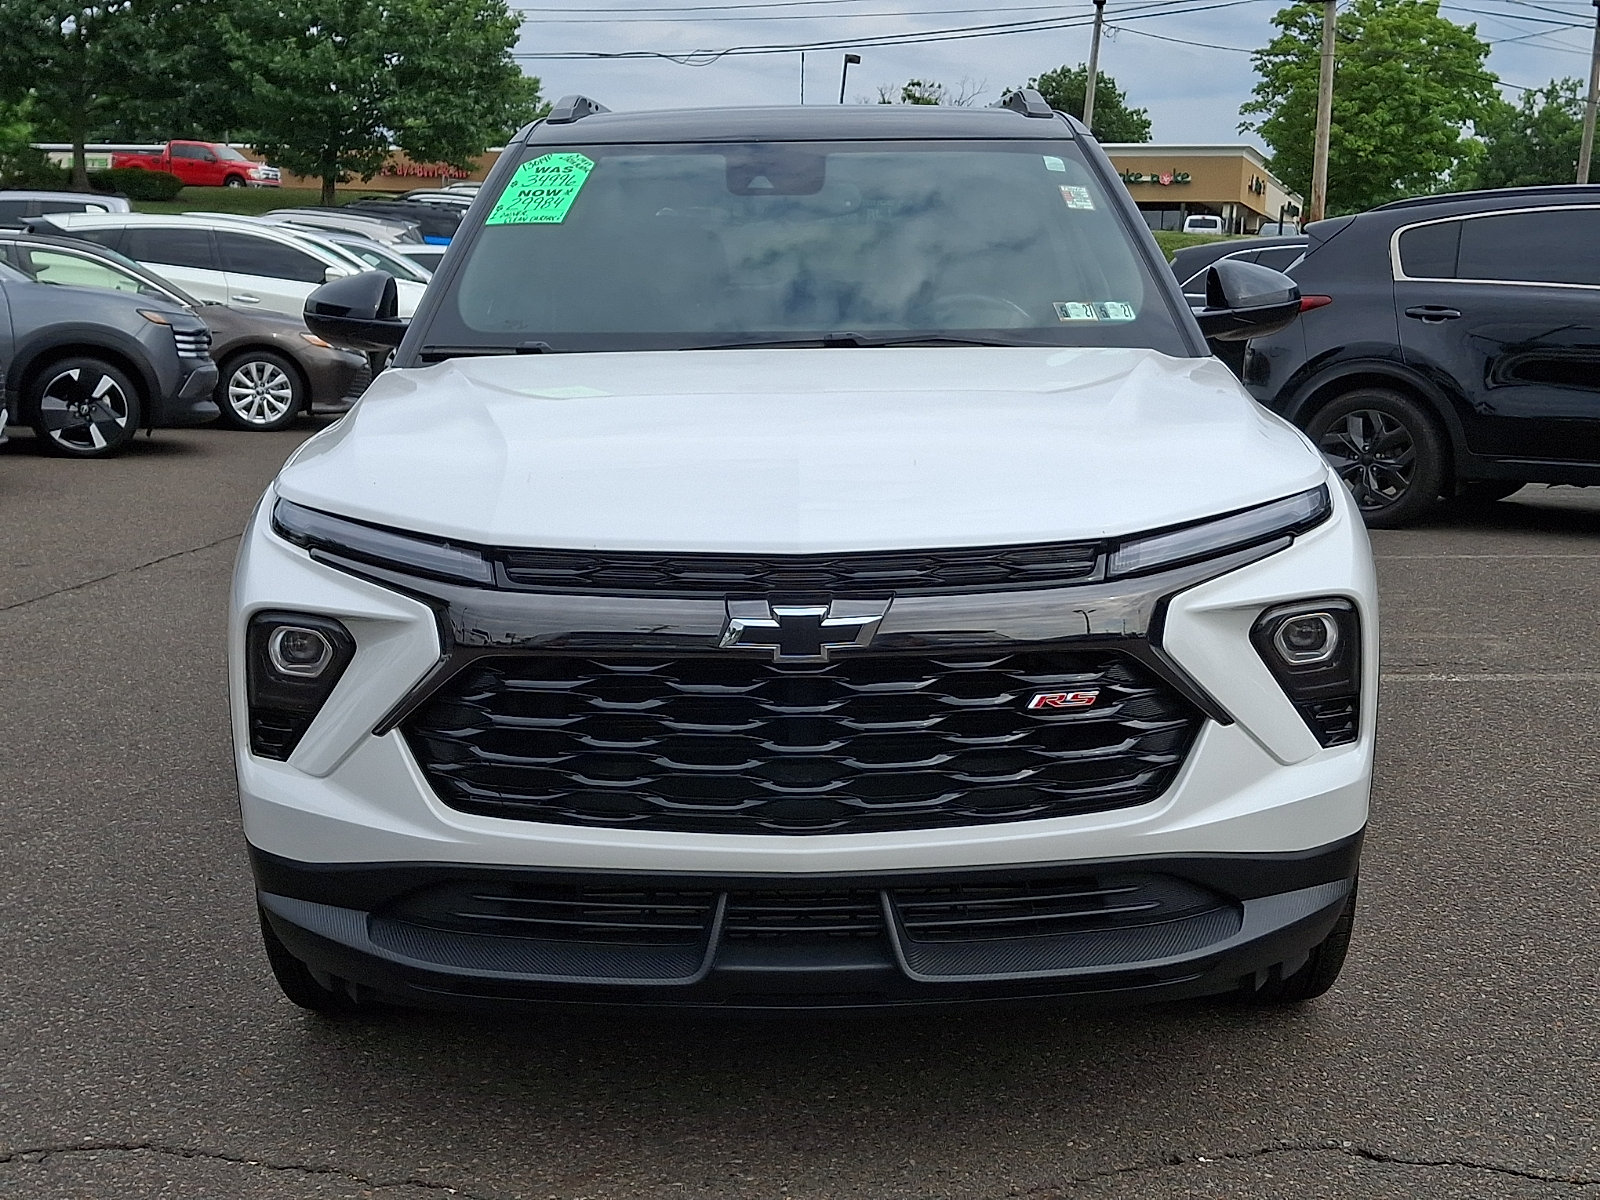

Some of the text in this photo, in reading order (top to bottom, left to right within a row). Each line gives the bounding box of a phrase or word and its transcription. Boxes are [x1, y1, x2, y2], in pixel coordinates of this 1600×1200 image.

[535, 166, 574, 174] WAS
[518, 189, 563, 197] NOW
[1028, 690, 1099, 708] RS
